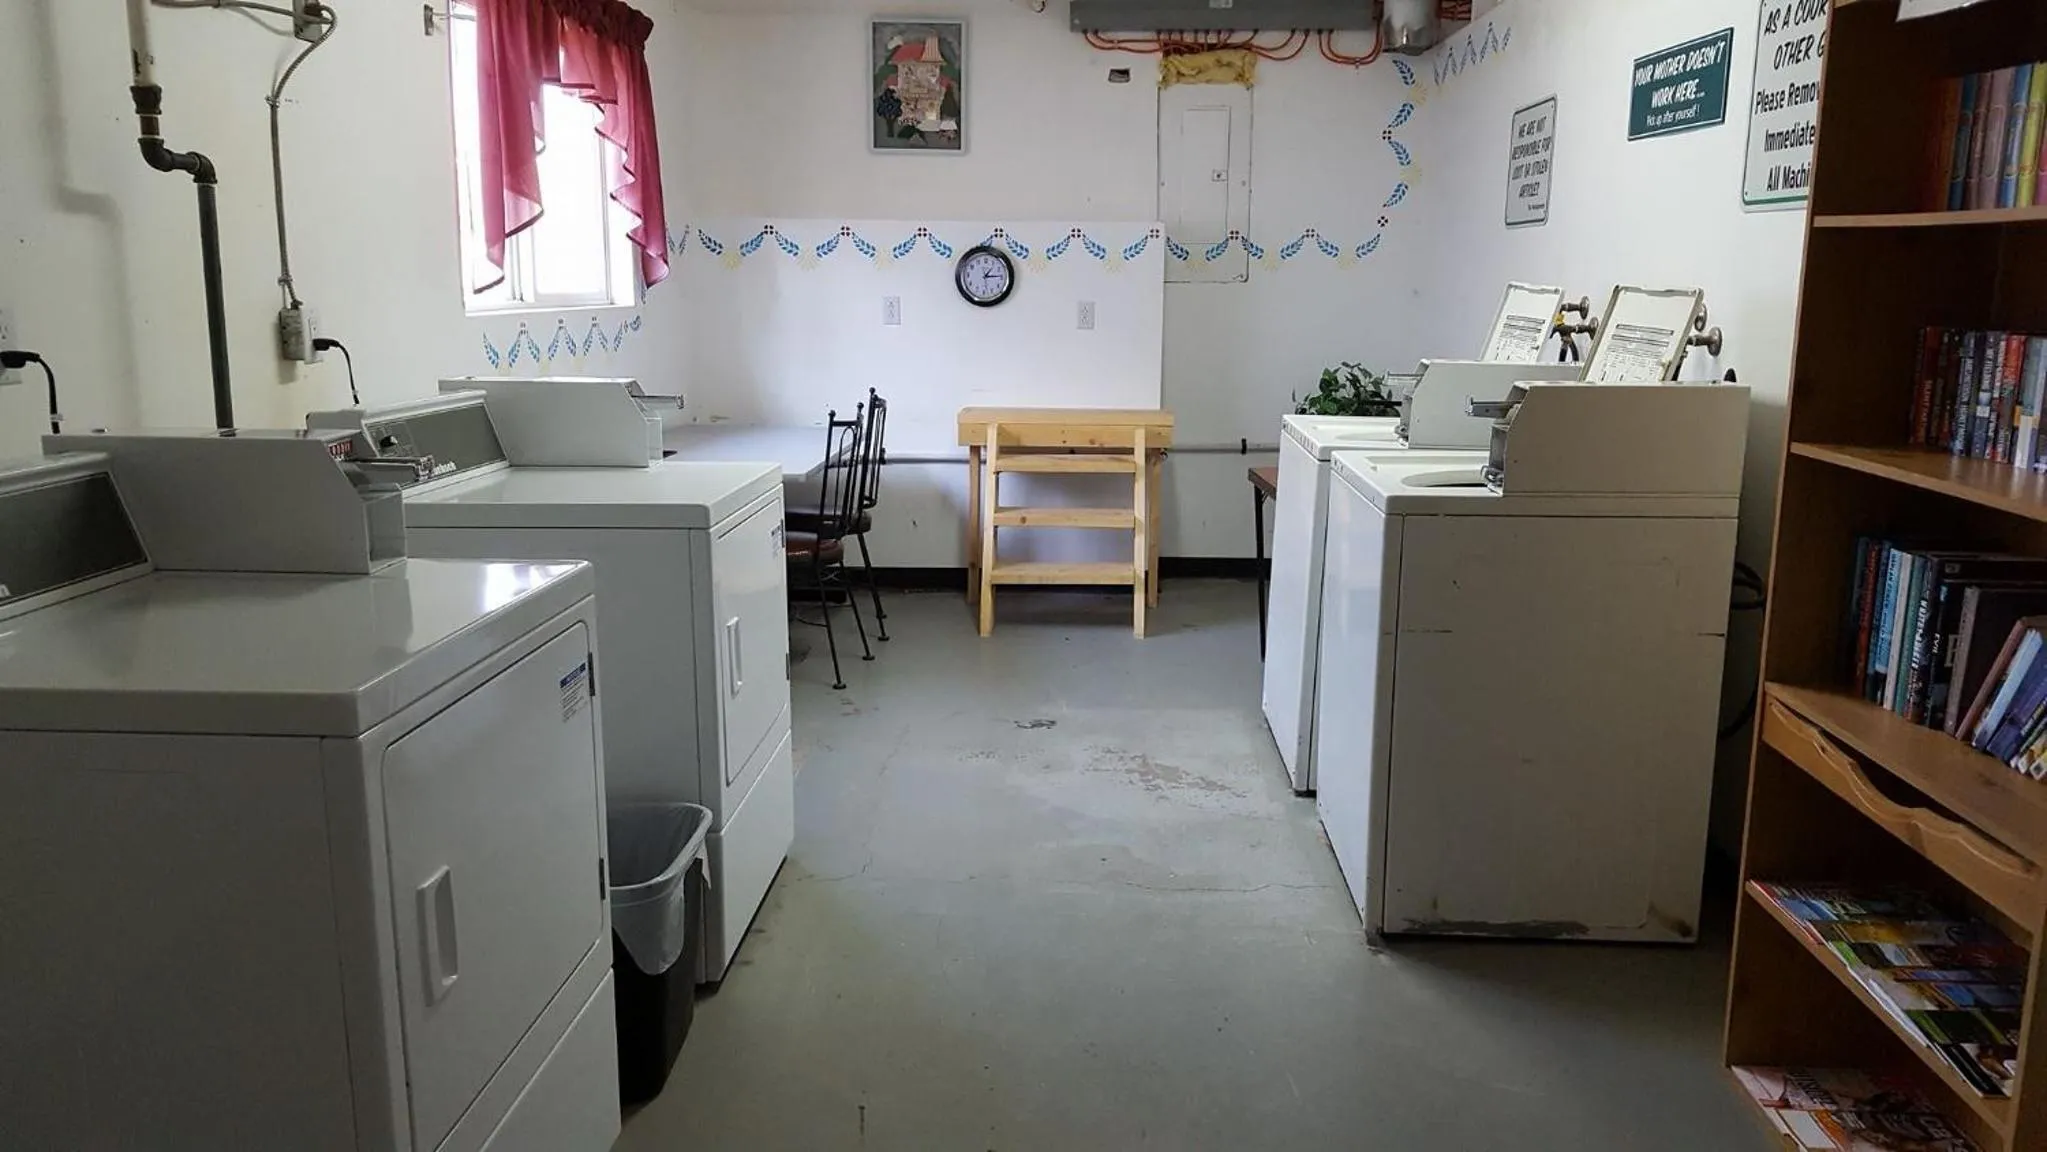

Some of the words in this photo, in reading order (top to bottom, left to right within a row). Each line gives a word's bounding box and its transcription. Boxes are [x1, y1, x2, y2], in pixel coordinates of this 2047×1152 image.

[1764, 8, 1781, 36] AS
[1781, 3, 1792, 31] A
[1634, 65, 1653, 87] YOUR
[1653, 55, 1686, 81] MOTHER
[1686, 41, 1725, 70] DOESN'T
[1773, 33, 1815, 70] OTHER
[1651, 86, 1676, 108] WORK
[1755, 89, 1785, 115] Please
[1662, 109, 1674, 124] after
[1767, 166, 1781, 191] All
